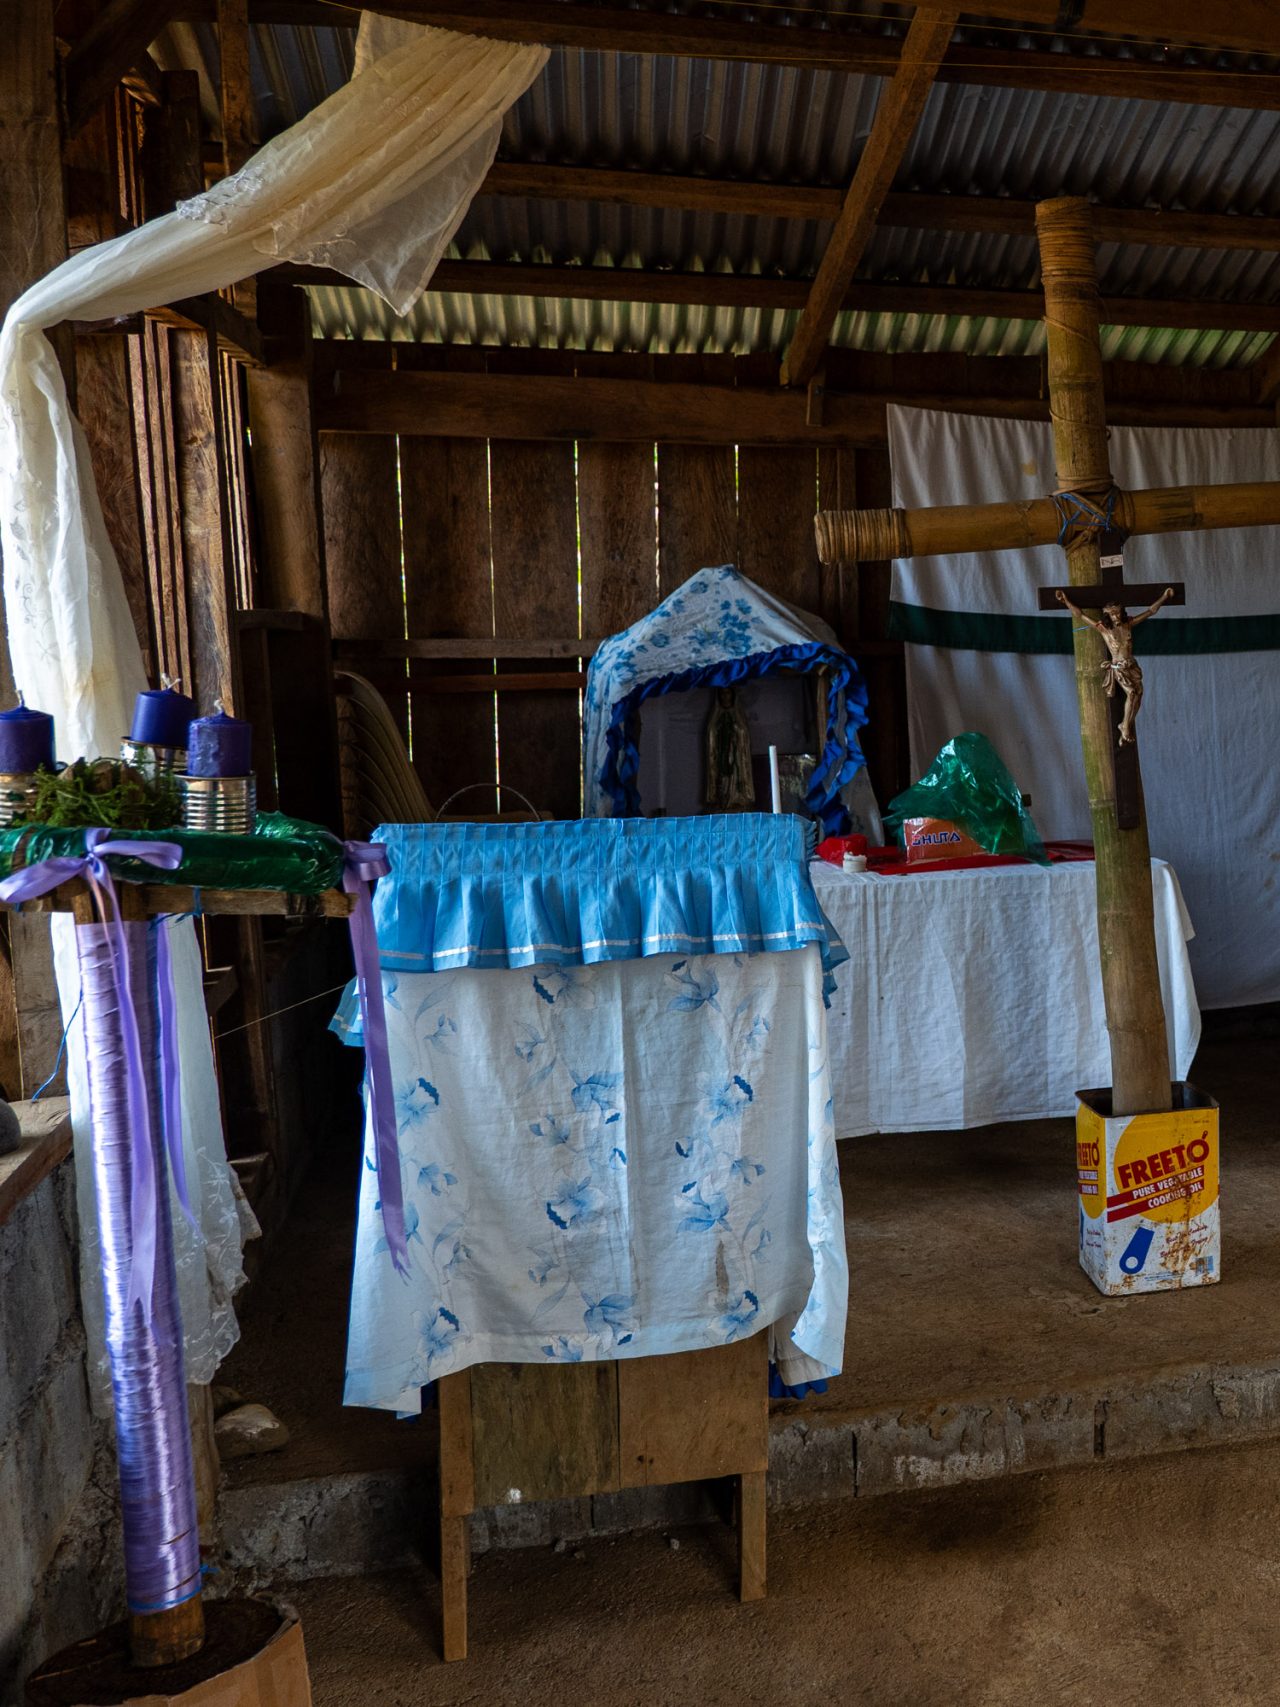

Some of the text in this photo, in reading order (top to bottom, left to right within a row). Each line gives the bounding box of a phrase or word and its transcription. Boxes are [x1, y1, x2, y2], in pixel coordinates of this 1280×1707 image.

[1117, 1131, 1210, 1189] FREETO
[1132, 1167, 1204, 1200] PURE VEGTABLE
[1147, 1188, 1187, 1209] COOKING
